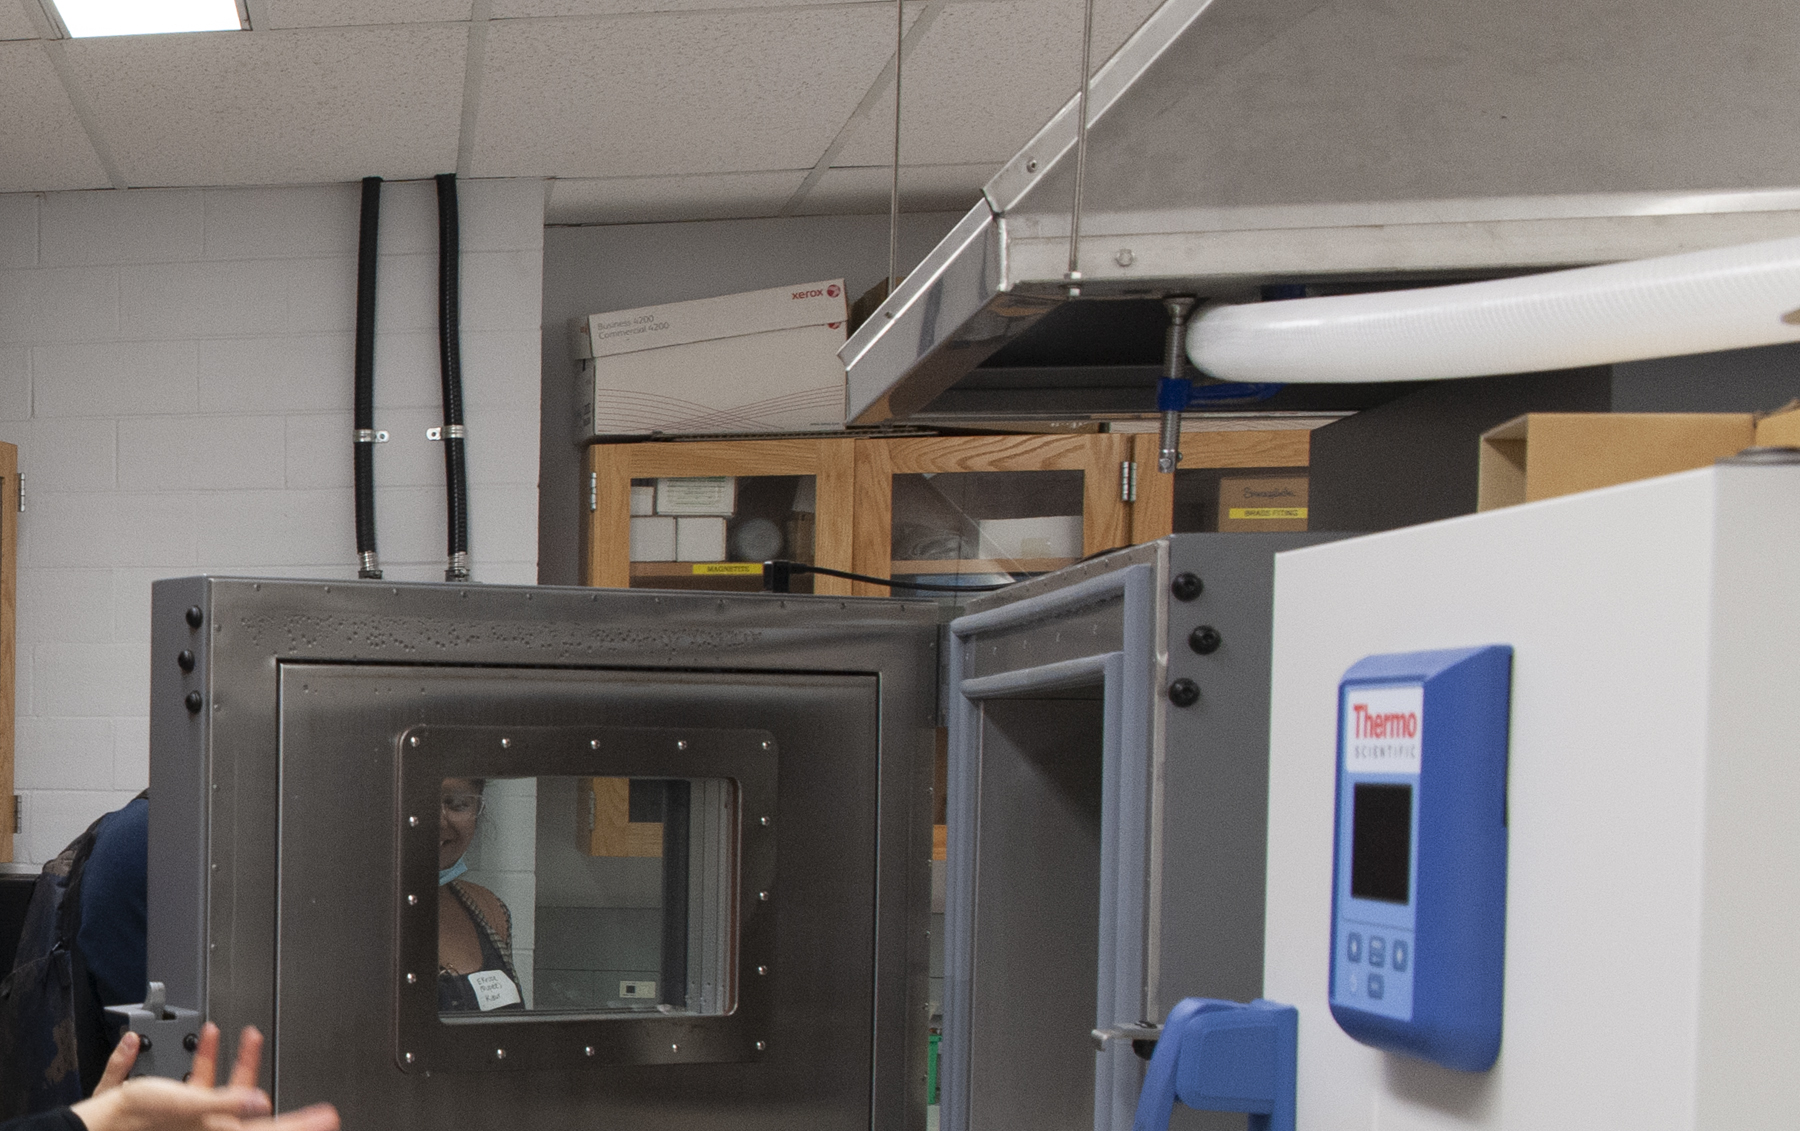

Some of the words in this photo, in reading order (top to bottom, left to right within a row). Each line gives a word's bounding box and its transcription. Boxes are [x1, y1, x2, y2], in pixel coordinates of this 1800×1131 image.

[791, 287, 824, 301] xerox
[597, 320, 632, 332] Business
[633, 315, 655, 326] 4200
[598, 325, 647, 340] Commercial
[647, 321, 670, 332] 4200
[1353, 704, 1418, 739] Thermo
[1355, 744, 1416, 759] SCIENTIFIC
